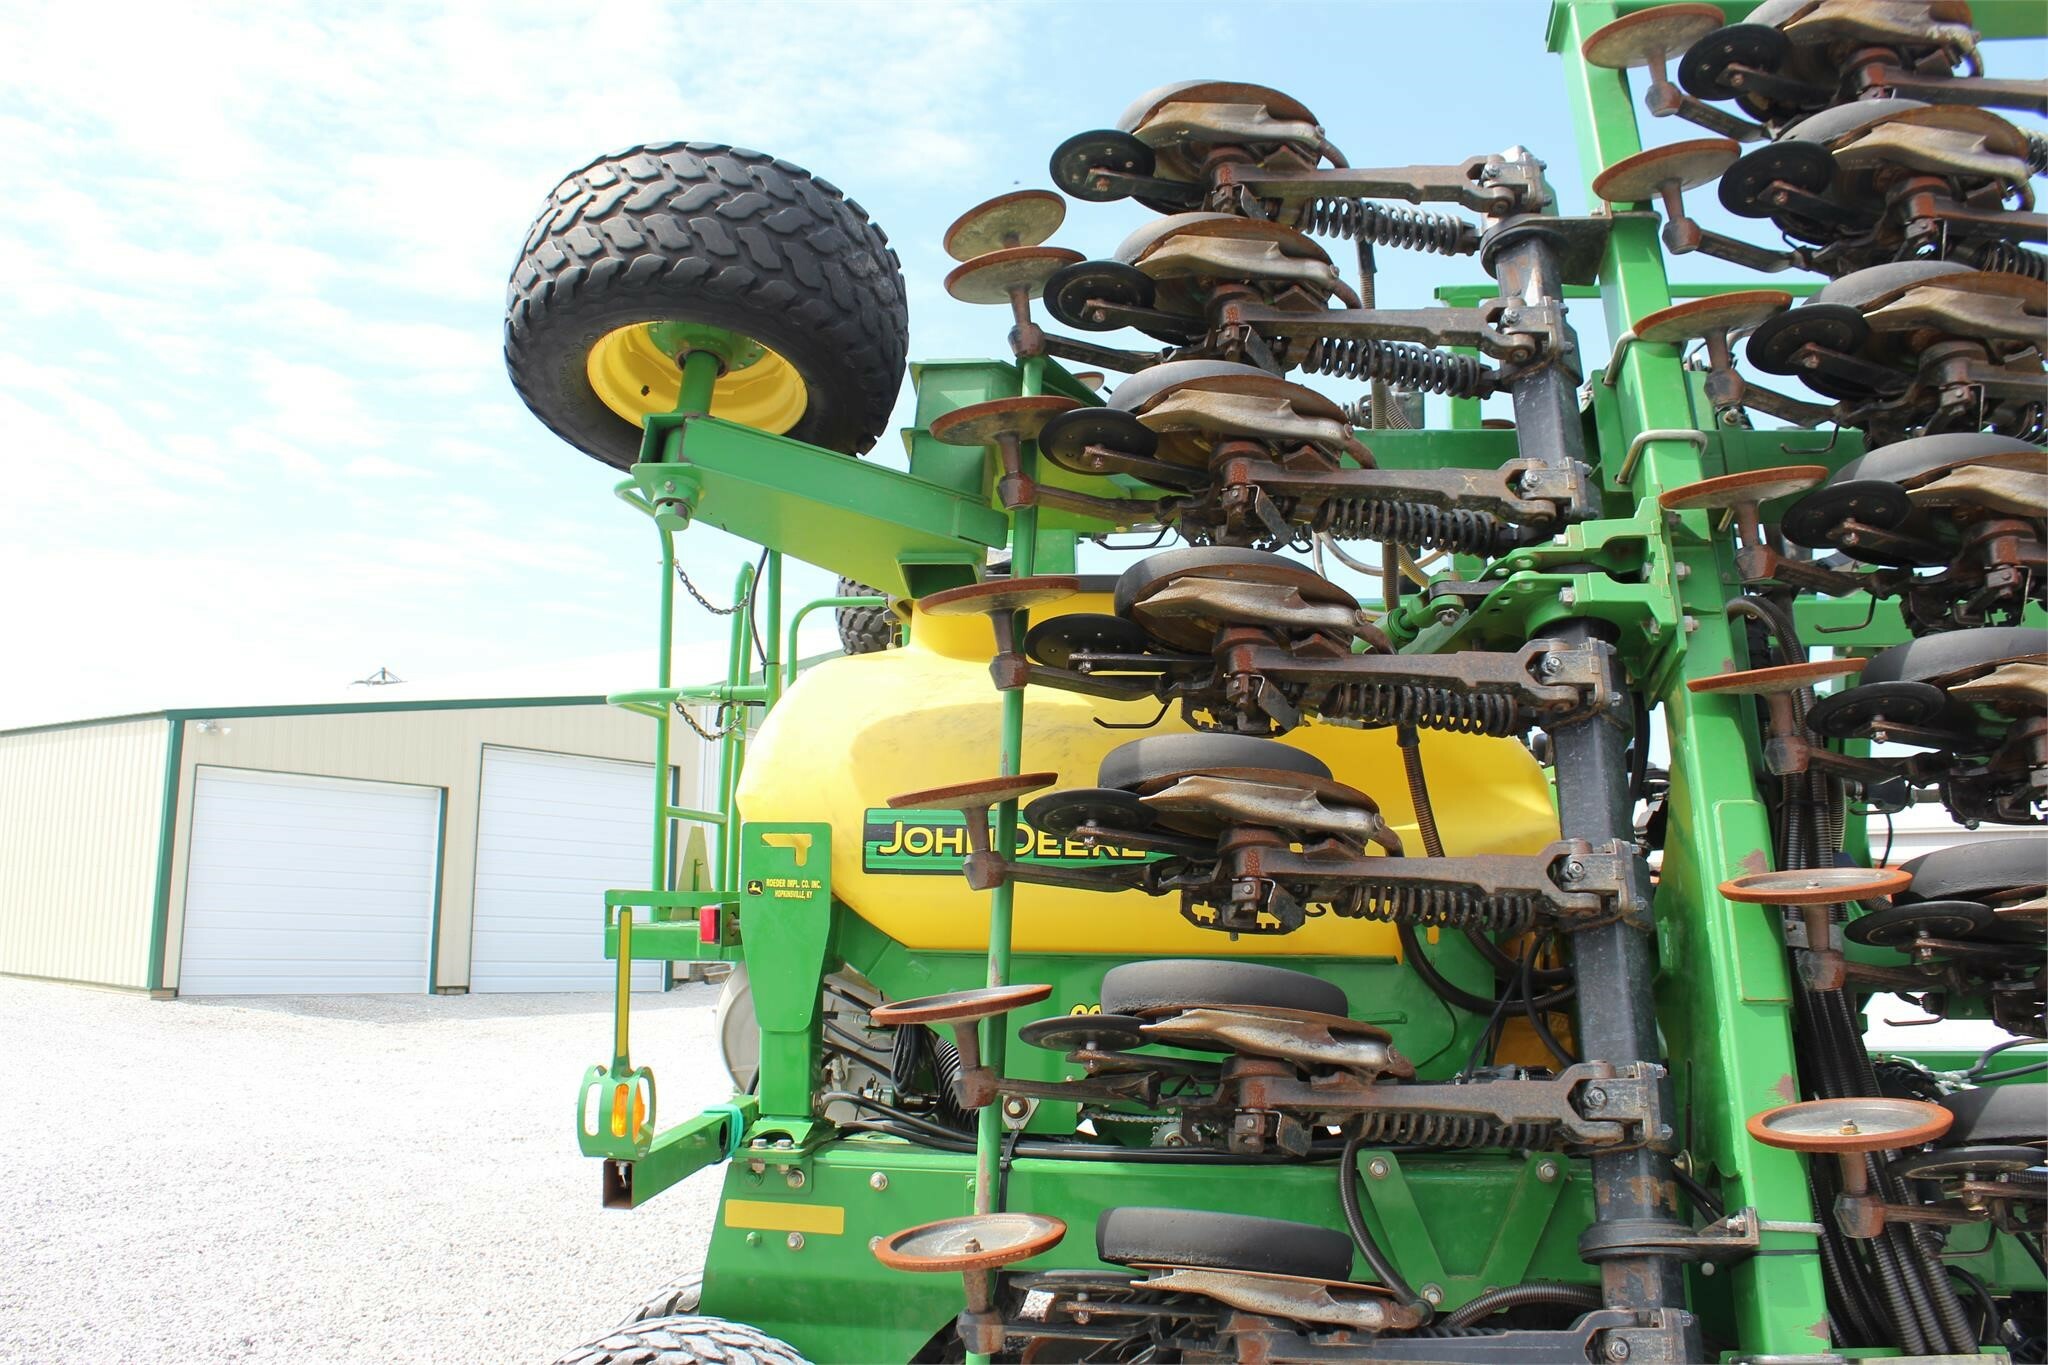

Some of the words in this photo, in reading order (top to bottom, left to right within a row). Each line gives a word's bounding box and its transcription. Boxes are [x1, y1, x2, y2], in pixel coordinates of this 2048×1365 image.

[766, 878, 786, 888] ROEDER
[802, 879, 810, 889] CO.
[811, 880, 822, 889] INC.
[806, 890, 813, 899] KY
